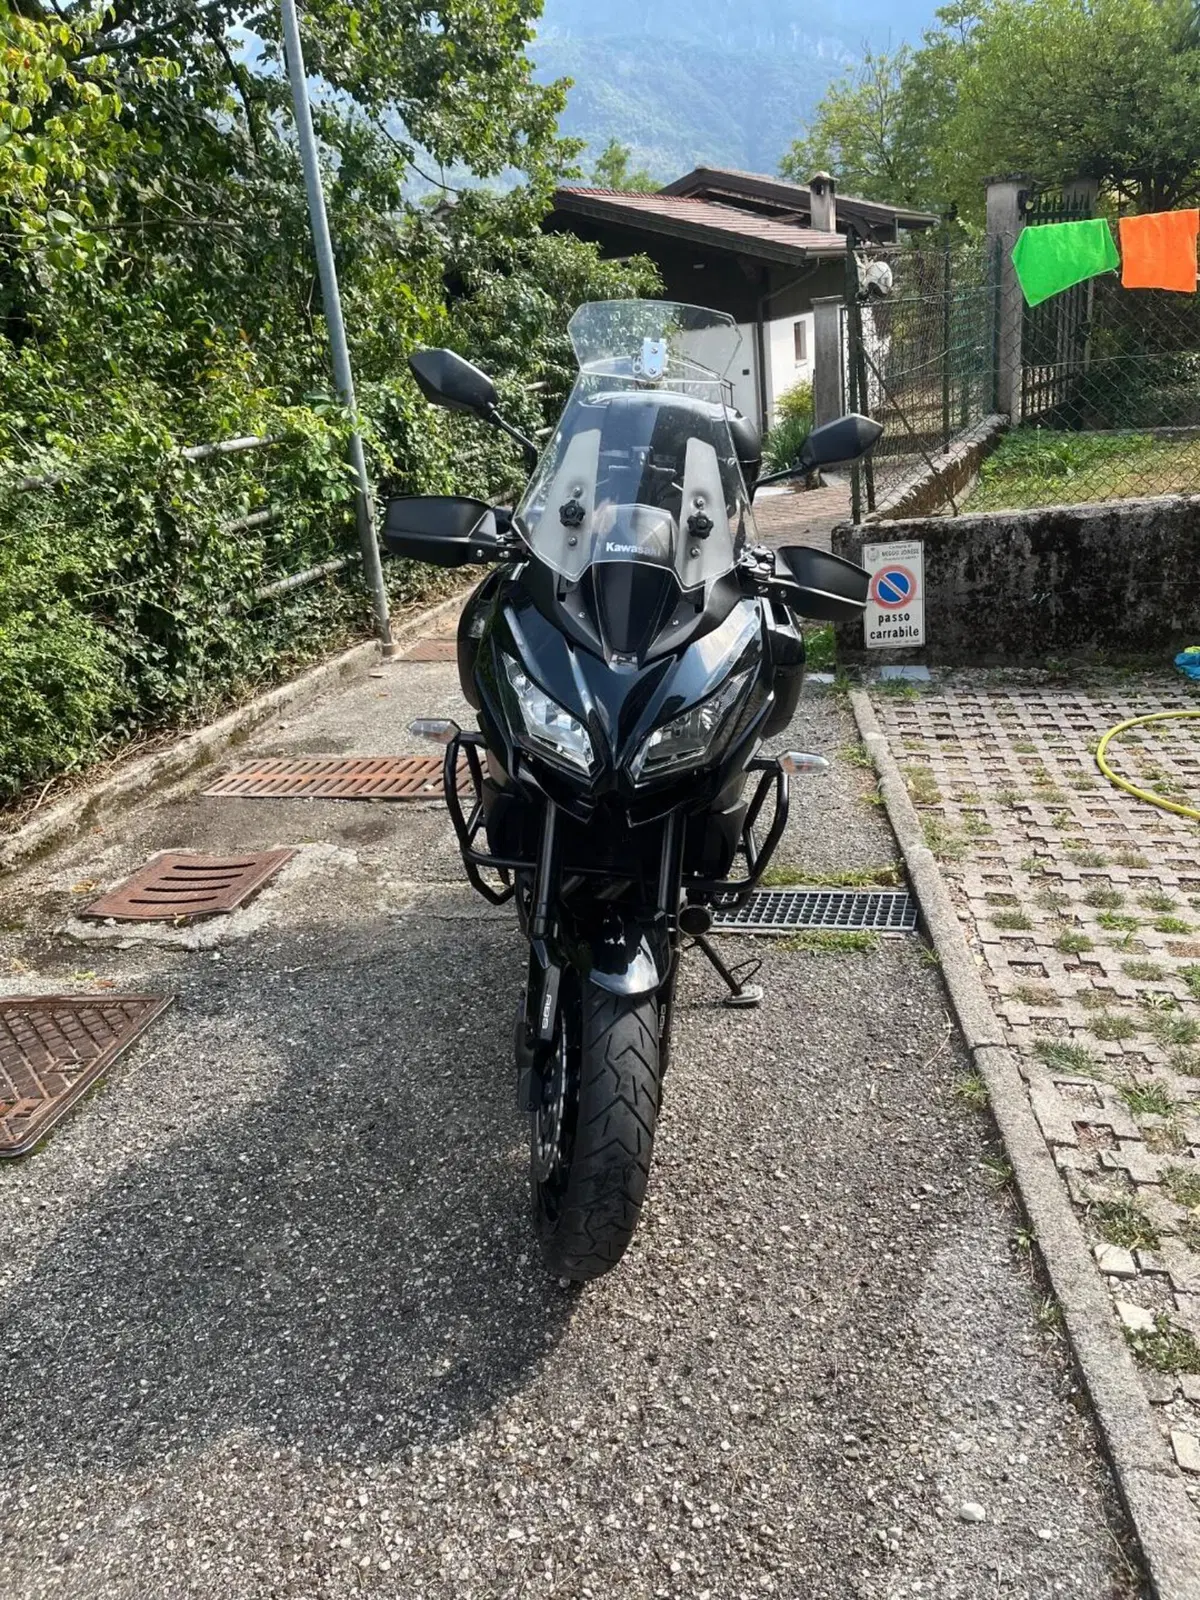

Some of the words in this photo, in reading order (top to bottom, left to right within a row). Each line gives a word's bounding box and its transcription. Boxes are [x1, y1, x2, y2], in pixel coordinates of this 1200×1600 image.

[605, 541, 661, 557] Kawasaki
[878, 612, 910, 626] passo
[870, 625, 919, 640] carrabile
